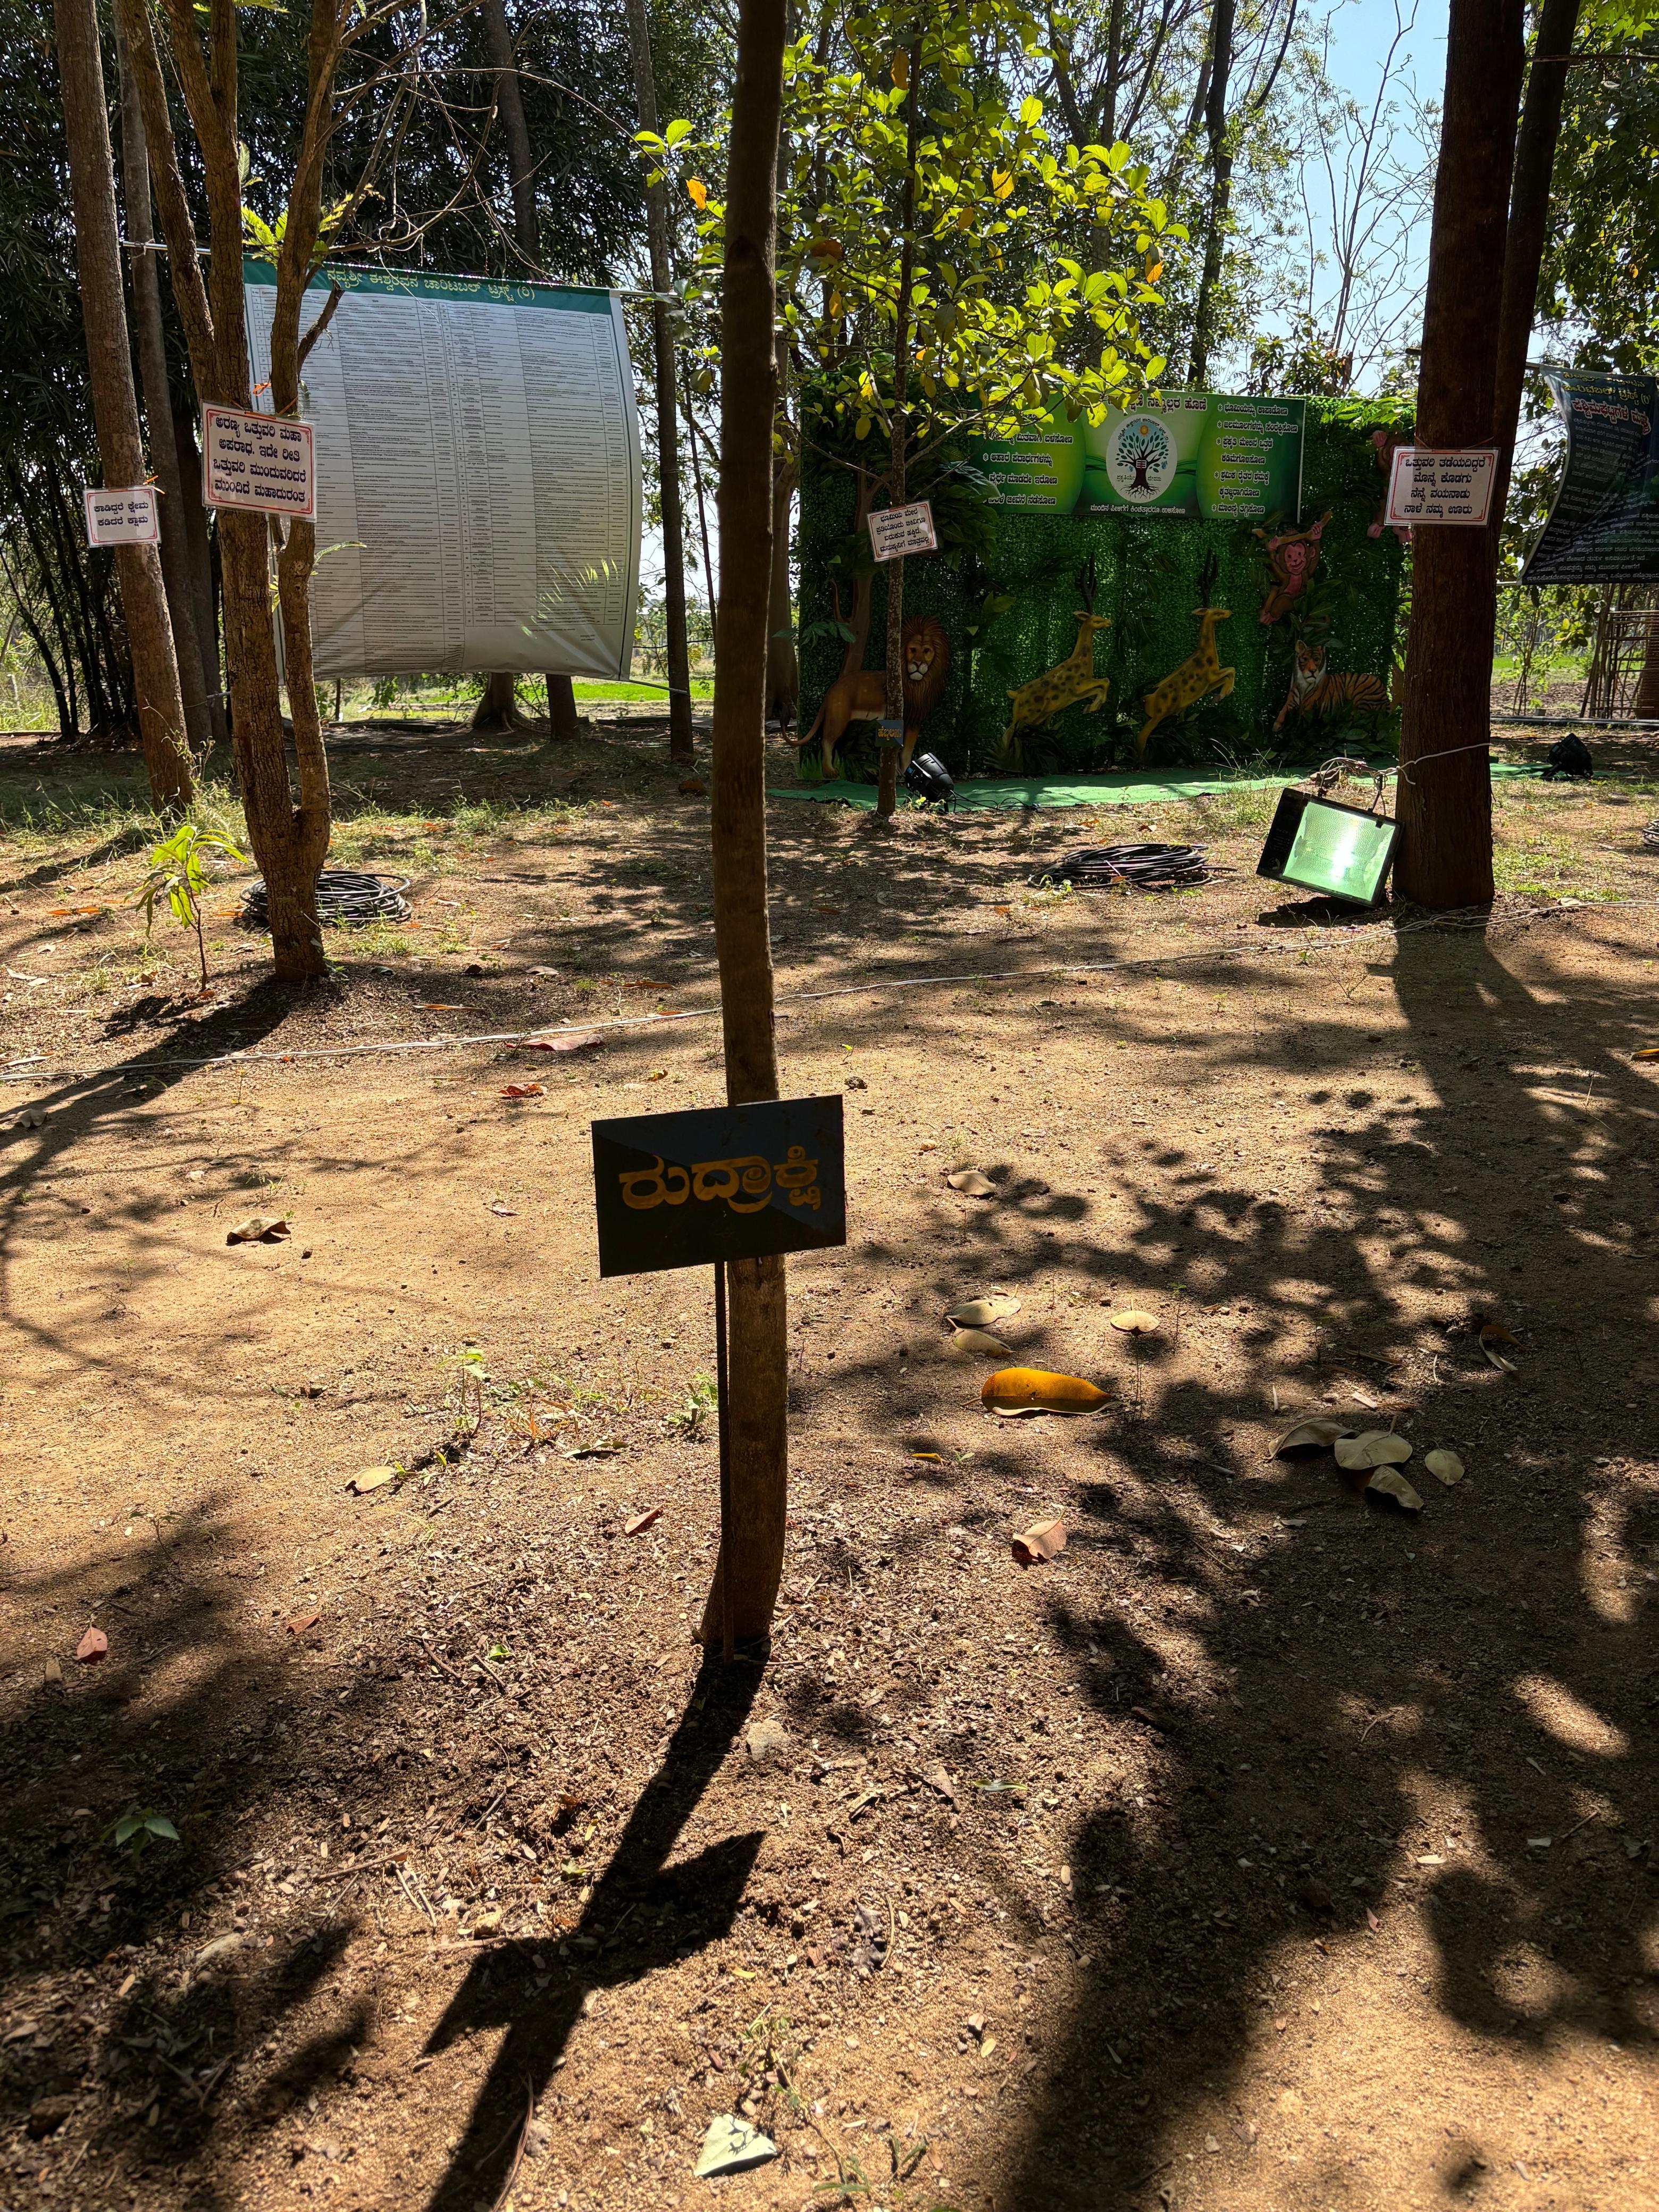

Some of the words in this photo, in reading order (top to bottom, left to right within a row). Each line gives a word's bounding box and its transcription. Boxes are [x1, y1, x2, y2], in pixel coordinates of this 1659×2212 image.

[370, 272, 419, 291] ಈಶ್ವರವನ
[424, 278, 481, 293] ಚಾರಿಟಬಲ್
[488, 283, 515, 303] ಟ್ರಸ್ಟ್
[517, 285, 535, 300] (ರಿ)
[1185, 397, 1207, 410] ಹೊಣೆ
[1224, 403, 1256, 417] ಭೂಮಿಯನ್ನು
[216, 415, 241, 438] ಅರಣ್ಯ
[244, 421, 275, 440] ಒತ್ತುವರಿ
[280, 426, 301, 442] ಮಹಾ
[219, 438, 254, 456] ಅಪರಾಧ.
[259, 443, 278, 458] ಇದೇ
[282, 448, 300, 462] ರೀತಿ
[213, 457, 245, 476] ಒತ್ತುವರಿ
[250, 462, 306, 483] ಮುಂದುವರಿದರೆ
[1405, 457, 1435, 471] ಒತ್ತುವರಿ
[1439, 457, 1485, 472] ತಡೆಯದಿದ್ದರೆ
[1414, 472, 1436, 487] ಮೊನ್ನೆ
[1441, 472, 1472, 483] ಕೊಡಗು
[215, 476, 250, 495] ಮುಂದಿದೆ
[255, 483, 305, 502] ಮಹಾದುರಂತ
[1411, 487, 1426, 502] ನೆನ್ನೆ
[1430, 488, 1470, 499] ವಯನಾಡು
[94, 502, 123, 515] ಕಾಡಿದ್ದರೆ
[128, 501, 148, 514] ಕ್ಷೇಮ
[880, 512, 902, 523] ಭೂಮಿಯ
[904, 507, 918, 517] ಮೇಲೆ
[1404, 503, 1422, 514] ನಾಳೆ
[1426, 504, 1444, 518] ನಮ್ಮ
[1448, 504, 1472, 514] ಊರು
[98, 517, 123, 526] ಕಡಿದರೆ
[128, 515, 148, 527] ಕ್ಷಾಮ
[876, 522, 904, 535] ಪ್ರತಿಯೊಂದು
[884, 530, 905, 541] ಬದುಕುವ
[879, 540, 906, 552] ಮನುಷ್ಯನಿಗೆ
[618, 1145, 821, 1214] ರುದ್ರಾಕ್ಷಿ
